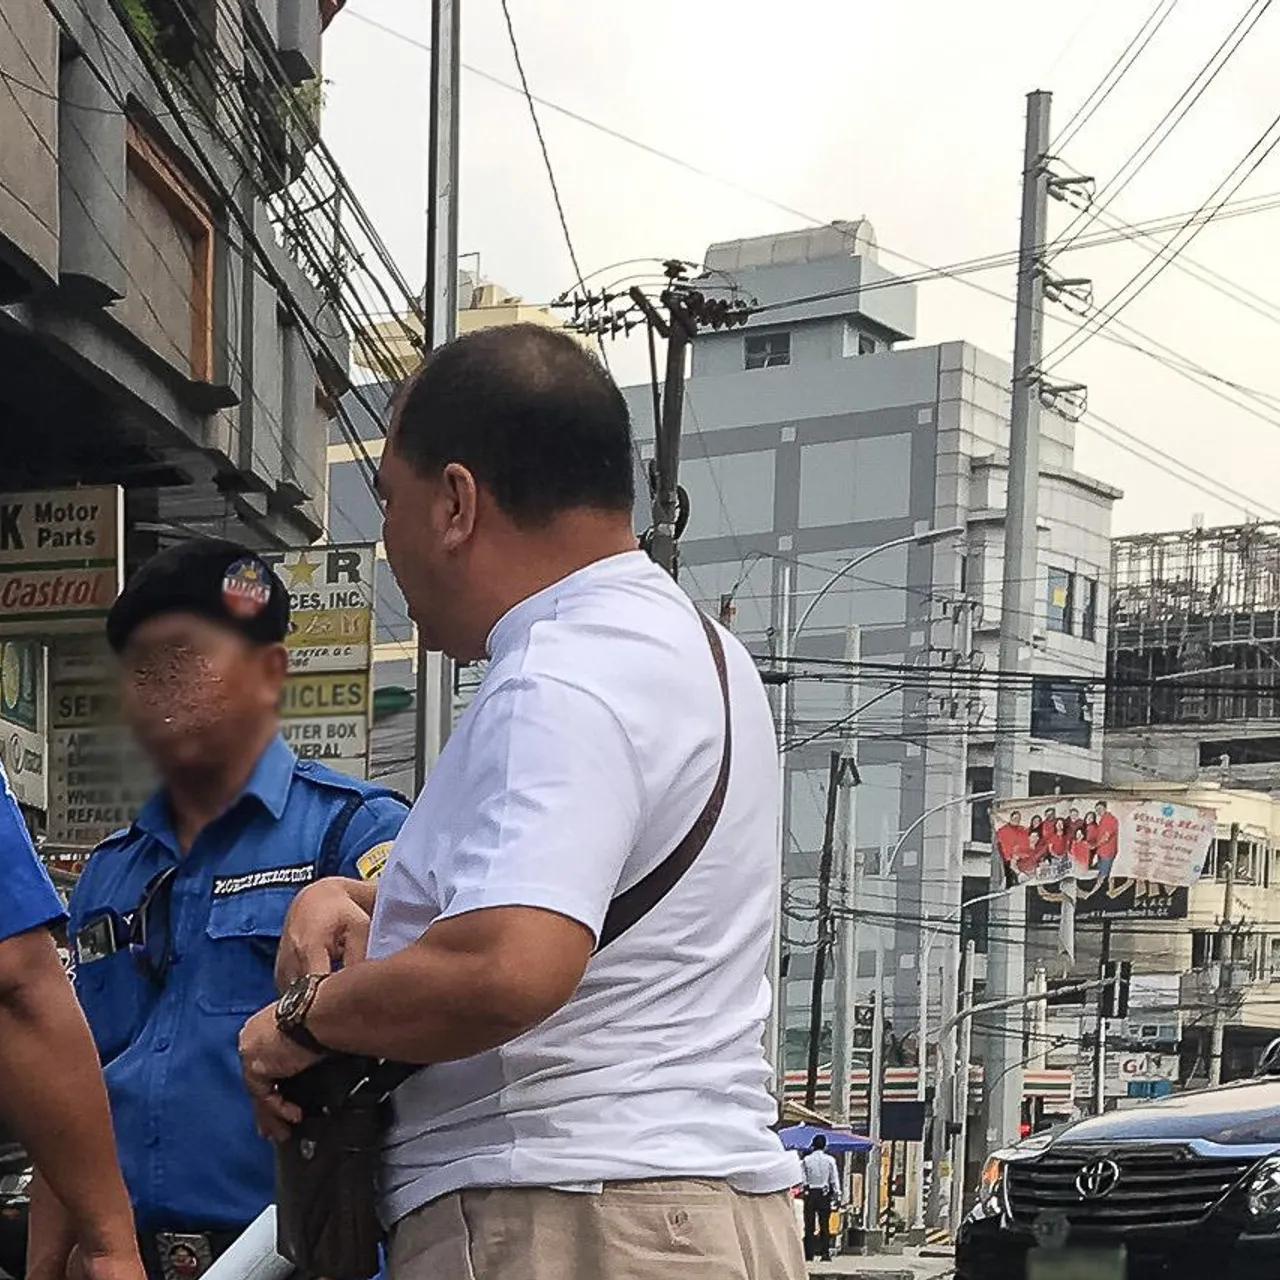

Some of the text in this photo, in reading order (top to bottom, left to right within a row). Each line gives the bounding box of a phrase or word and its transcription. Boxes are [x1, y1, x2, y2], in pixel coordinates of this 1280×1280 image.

[34, 502, 99, 524] Motor
[36, 527, 97, 549] Parts
[0, 572, 103, 609] Castrol
[329, 590, 366, 608] INC.
[327, 723, 358, 739] BOX
